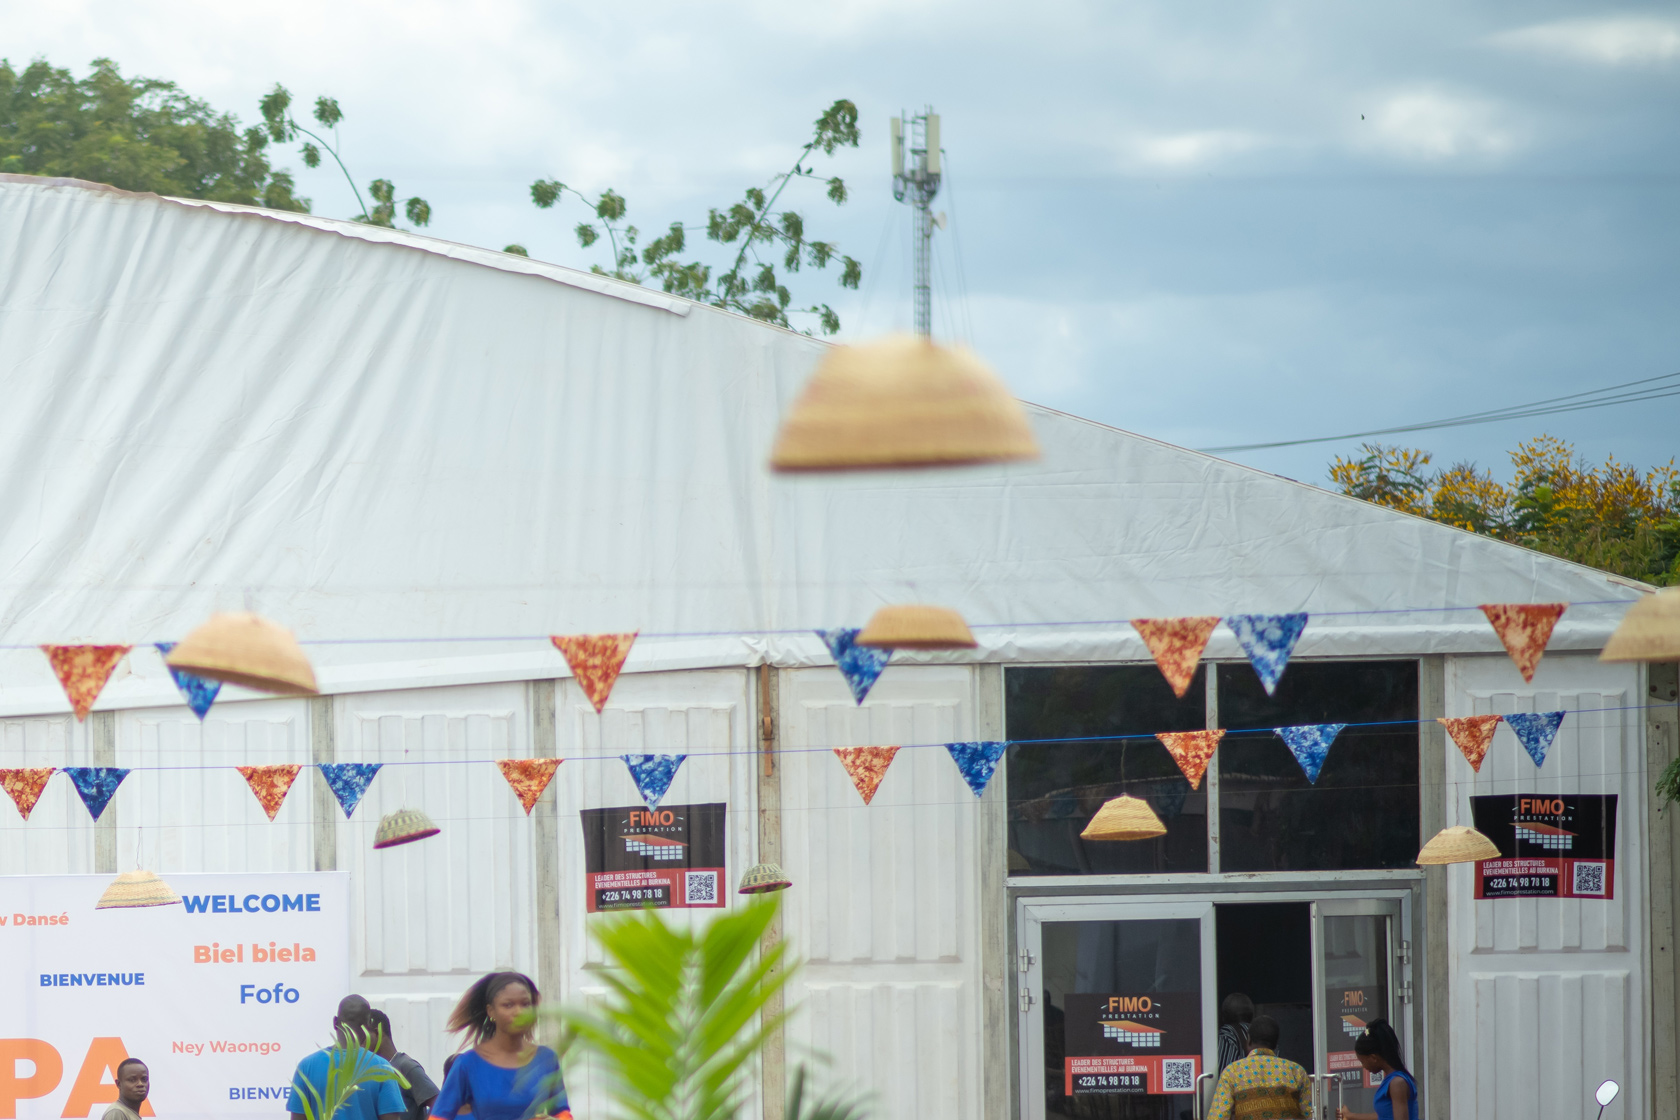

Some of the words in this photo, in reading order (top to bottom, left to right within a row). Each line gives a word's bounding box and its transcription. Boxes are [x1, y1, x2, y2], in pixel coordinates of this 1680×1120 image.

[1520, 799, 1565, 814] FIMO
[629, 811, 674, 826] FIMO
[1490, 879, 1506, 888] +226
[1509, 878, 1518, 887] 74
[1520, 878, 1529, 887] 98
[1531, 878, 1539, 886] 78
[1542, 878, 1549, 886] 18
[602, 891, 619, 901] +226
[621, 891, 630, 899] 74
[632, 890, 641, 899] 98
[643, 890, 652, 898] 78
[654, 889, 662, 898] 18
[182, 893, 321, 914] WELCOME
[13, 911, 69, 926] Dansé
[193, 942, 244, 964] Biel
[252, 941, 316, 963] biela
[39, 972, 145, 987] BIENVENUE
[240, 982, 300, 1005] Fofo
[1344, 991, 1364, 1006] FIMO
[1109, 996, 1152, 1012] FIMO
[172, 1041, 205, 1057] Ney
[209, 1040, 281, 1057] Waongo
[1078, 1077, 1095, 1086] +226
[1098, 1077, 1107, 1085] 74
[1109, 1076, 1118, 1085] 98
[1120, 1076, 1129, 1085] 78
[1131, 1076, 1140, 1085] 18
[229, 1086, 291, 1100] BIENVE
